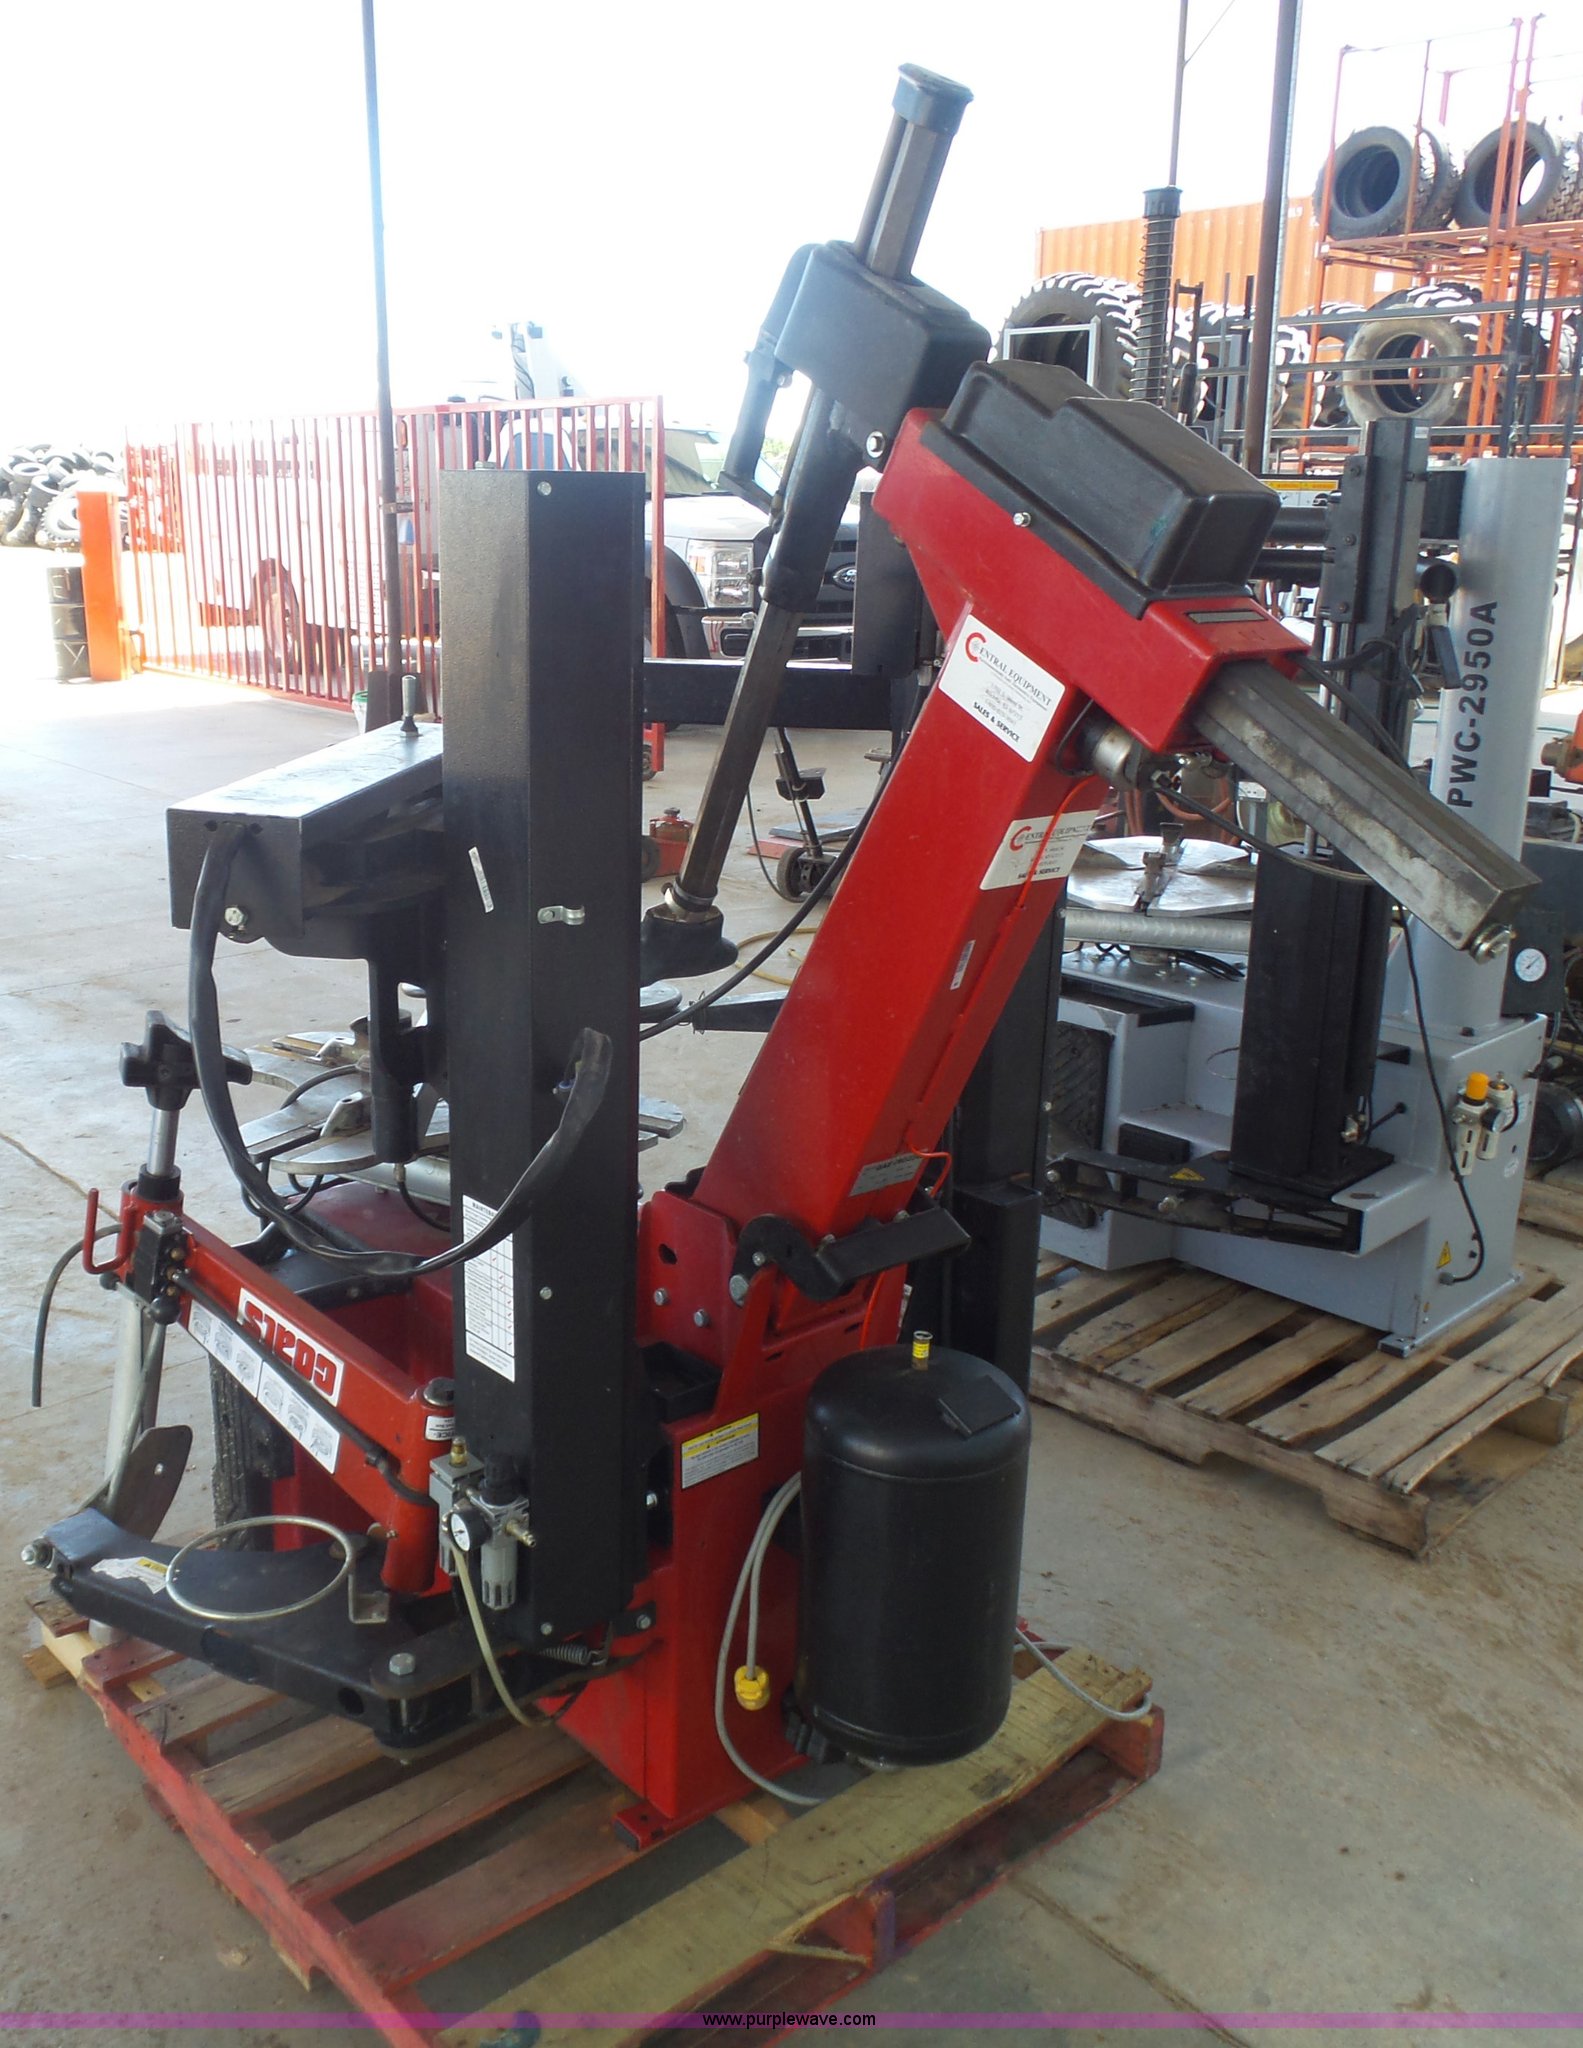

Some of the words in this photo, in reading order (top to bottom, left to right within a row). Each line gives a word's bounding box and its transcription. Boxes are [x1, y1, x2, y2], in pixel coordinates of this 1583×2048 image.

[965, 632, 1007, 672] CENTRAL
[1008, 666, 1052, 706] EQUIPMENT
[973, 702, 989, 718] SALES
[991, 715, 996, 723] &
[997, 720, 1020, 742] SERVICE
[1446, 601, 1498, 808] PWC-2950A
[1039, 867, 1061, 875] SERVICE
